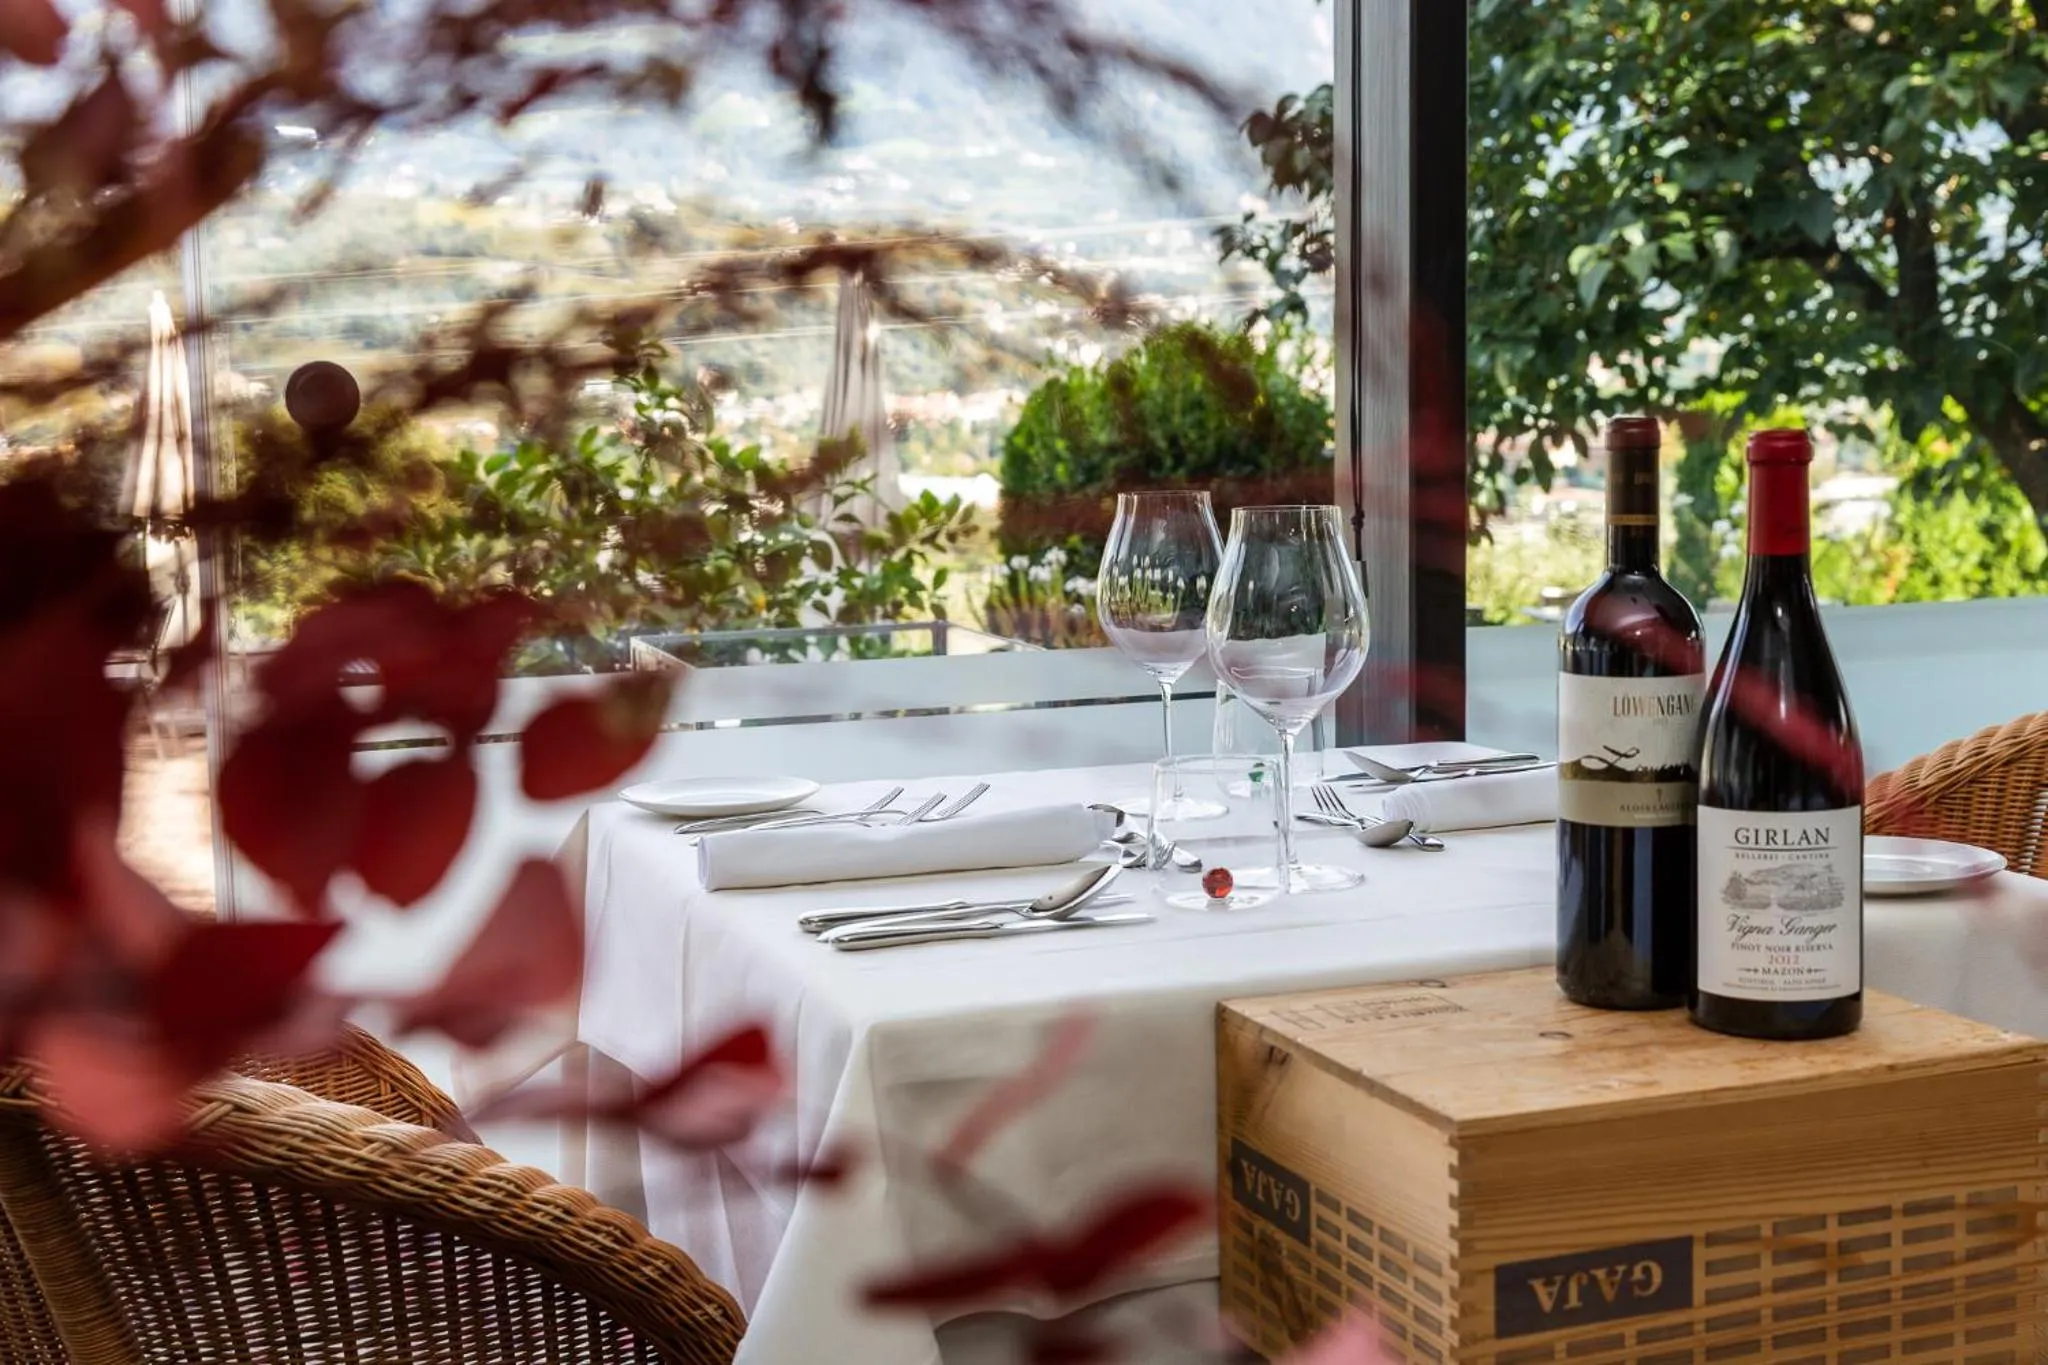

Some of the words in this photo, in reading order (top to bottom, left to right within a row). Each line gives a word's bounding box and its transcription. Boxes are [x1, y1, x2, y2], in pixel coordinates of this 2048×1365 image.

[1734, 826, 1830, 846] GIRLAN
[1726, 913, 1774, 941] Vigna
[1731, 942, 1761, 952] PINOT
[1765, 944, 1791, 953] NOIR
[1761, 967, 1804, 976] MAZON
[1240, 1159, 1300, 1222] GAJA
[1527, 1260, 1663, 1314] GAJA
